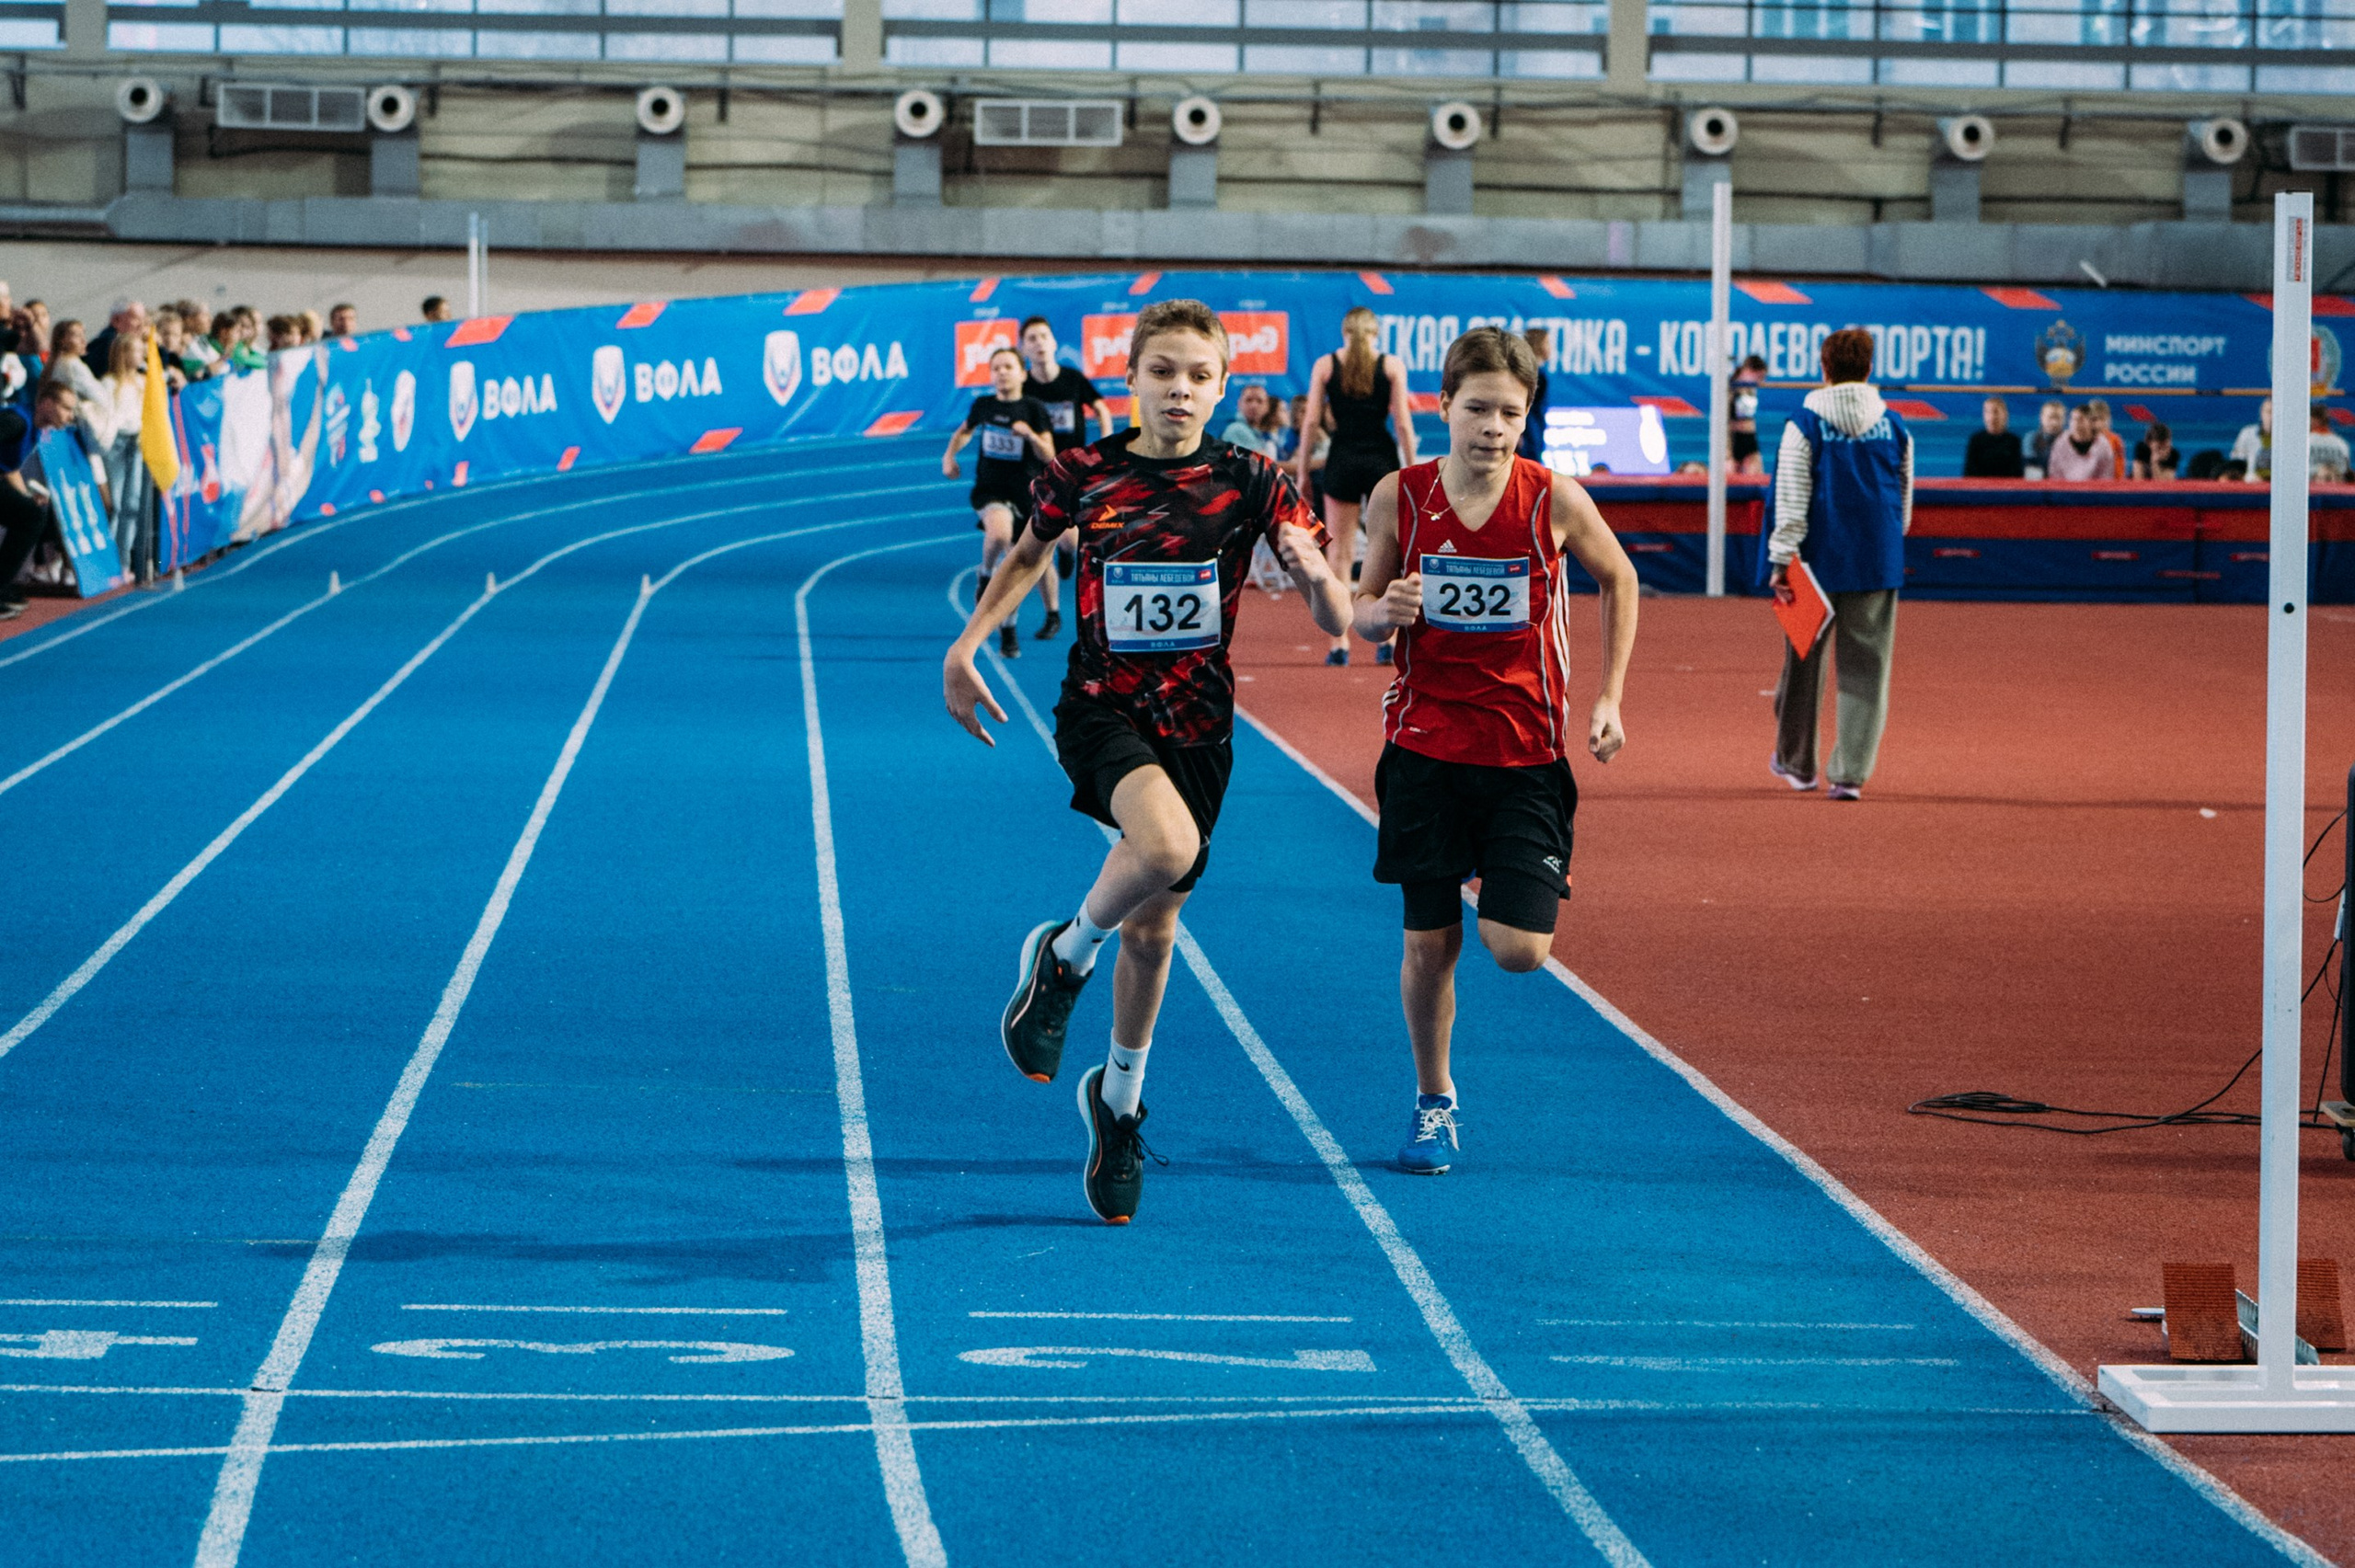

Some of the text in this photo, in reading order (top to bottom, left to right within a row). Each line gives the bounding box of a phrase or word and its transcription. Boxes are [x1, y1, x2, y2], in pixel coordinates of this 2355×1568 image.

[810, 340, 909, 386] ВФЛА
[1844, 324, 1986, 380] ПОРТА!
[2105, 335, 2226, 356] МИНСПОРТ
[634, 356, 723, 403] ВФЛА
[2105, 362, 2197, 383] РОССИИ
[482, 372, 557, 420] ВФЛА
[990, 432, 1016, 452] 333
[1090, 521, 1125, 530] DEMIX
[1124, 593, 1200, 632] 132
[1439, 582, 1511, 616] 232
